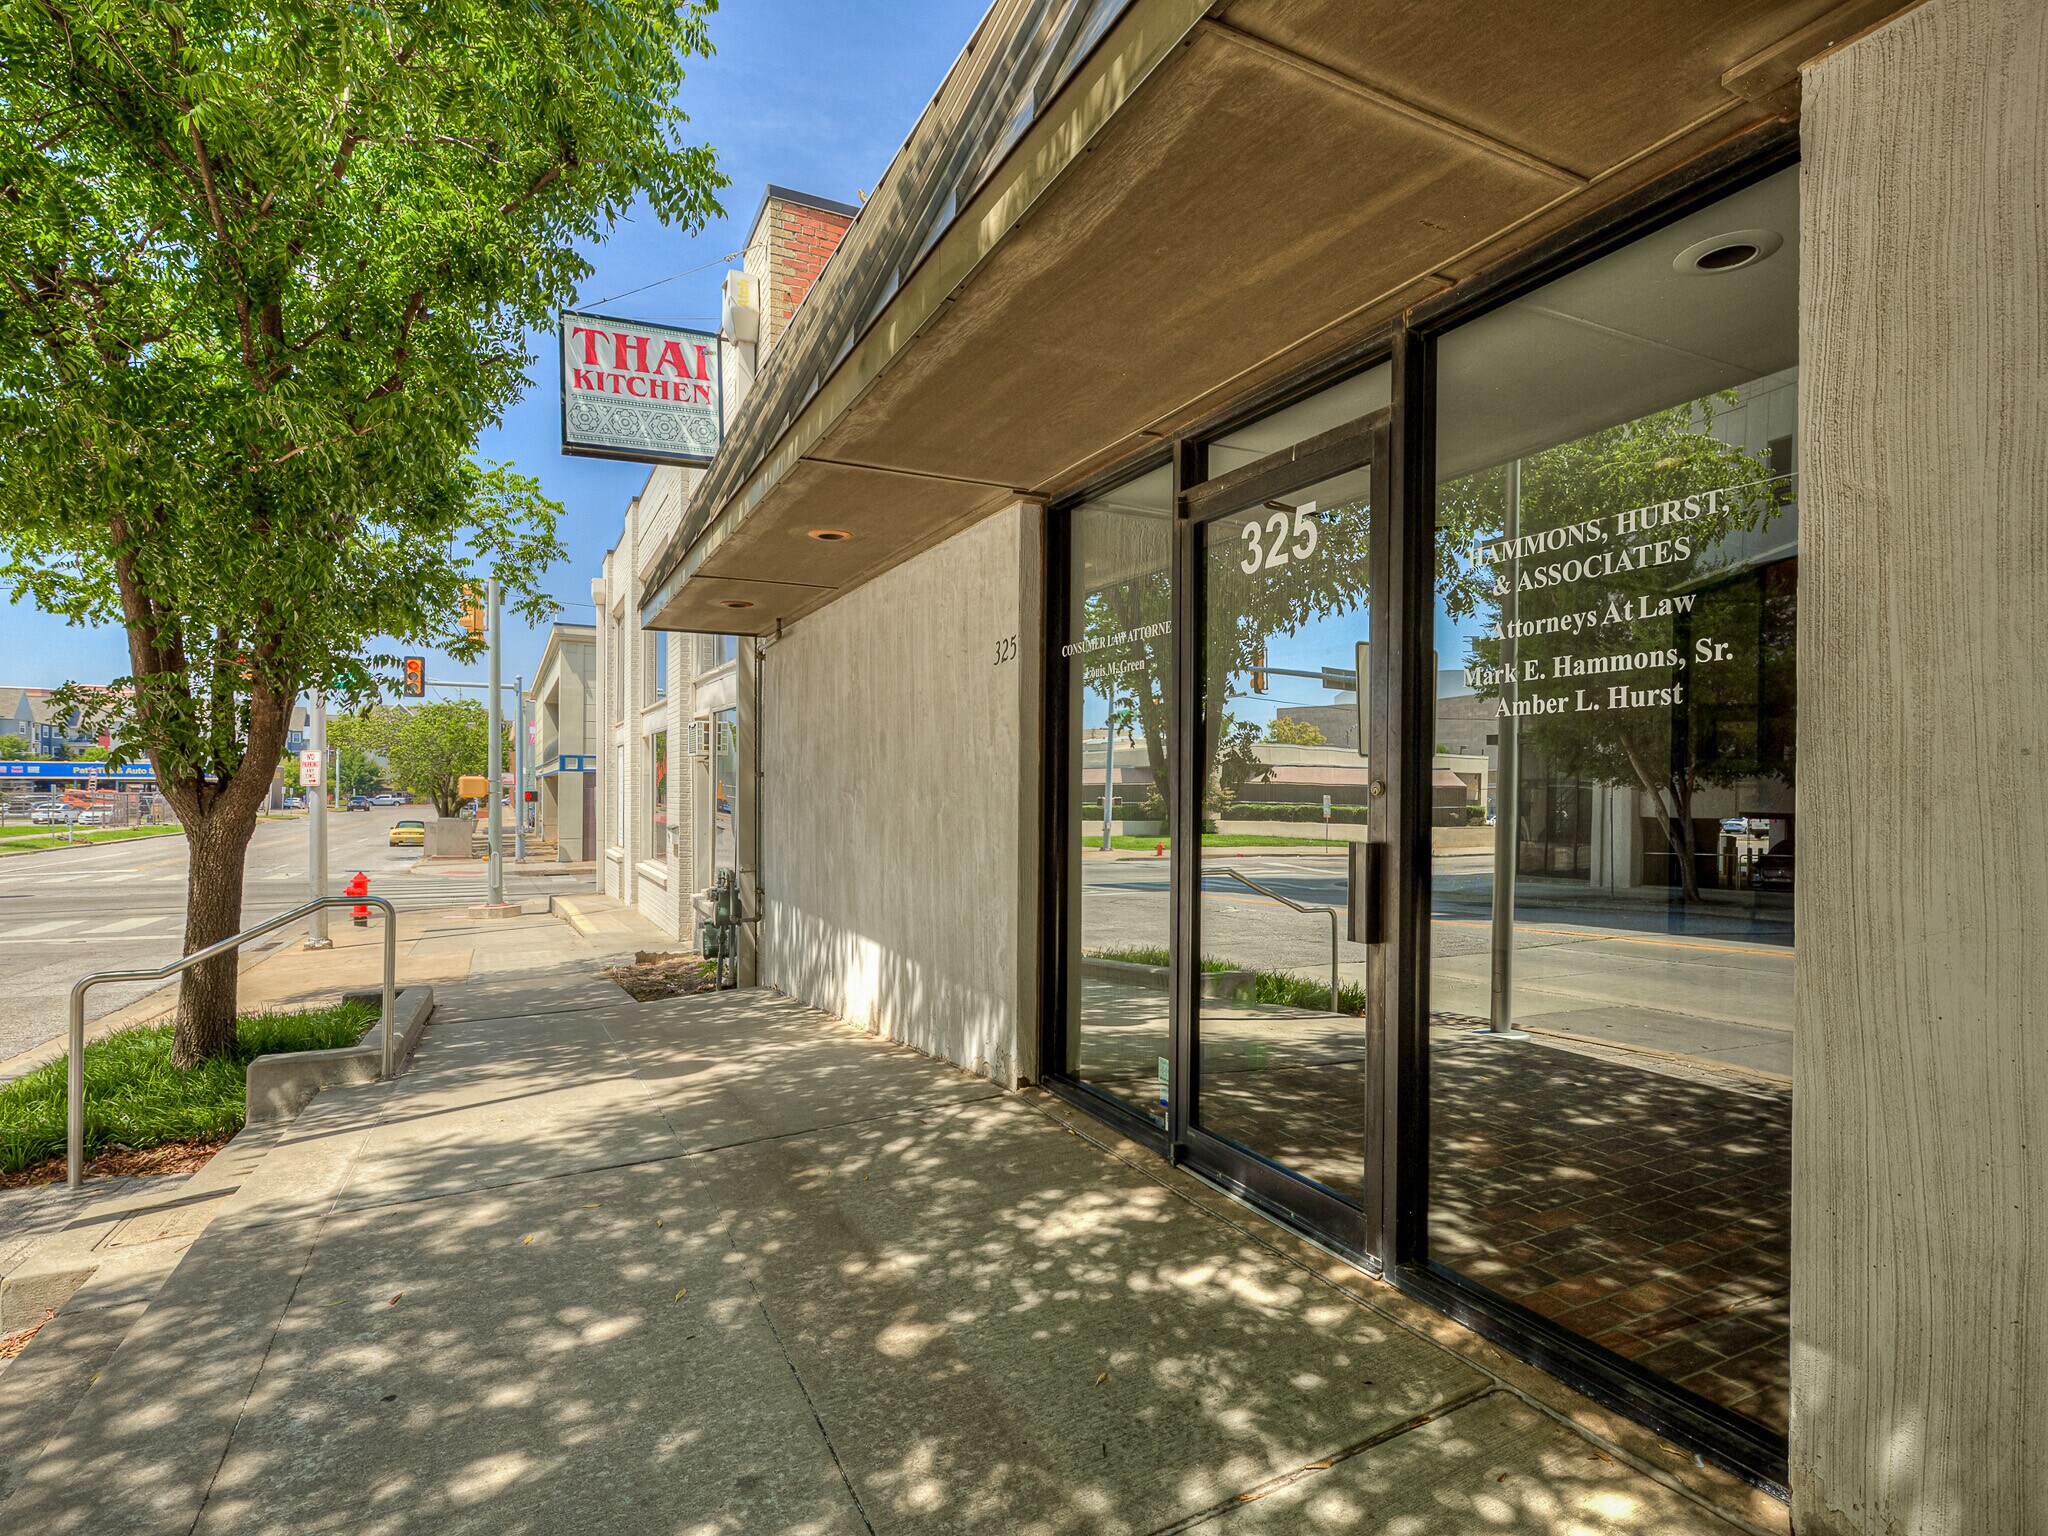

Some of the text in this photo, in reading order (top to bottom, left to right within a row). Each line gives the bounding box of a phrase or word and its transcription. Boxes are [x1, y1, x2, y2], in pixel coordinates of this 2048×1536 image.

[572, 327, 710, 381] THAI
[573, 368, 712, 405] KITCHEN
[1240, 501, 1317, 575] 325
[1469, 488, 1730, 568] HAMMONS, HURST,
[1492, 536, 1692, 597] & ASSOCIATES
[1490, 594, 1697, 642] Attorneys At Law
[993, 635, 1017, 666] 325
[1062, 636, 1105, 657] CONSUMER
[1107, 631, 1126, 647] LAW
[1463, 637, 1733, 688] Mark E. Hammons, Sr.
[1086, 664, 1106, 680] Louis
[1120, 659, 1145, 674] Green
[1495, 683, 1684, 718] Amber L. Hurst
[307, 753, 315, 761] NO
